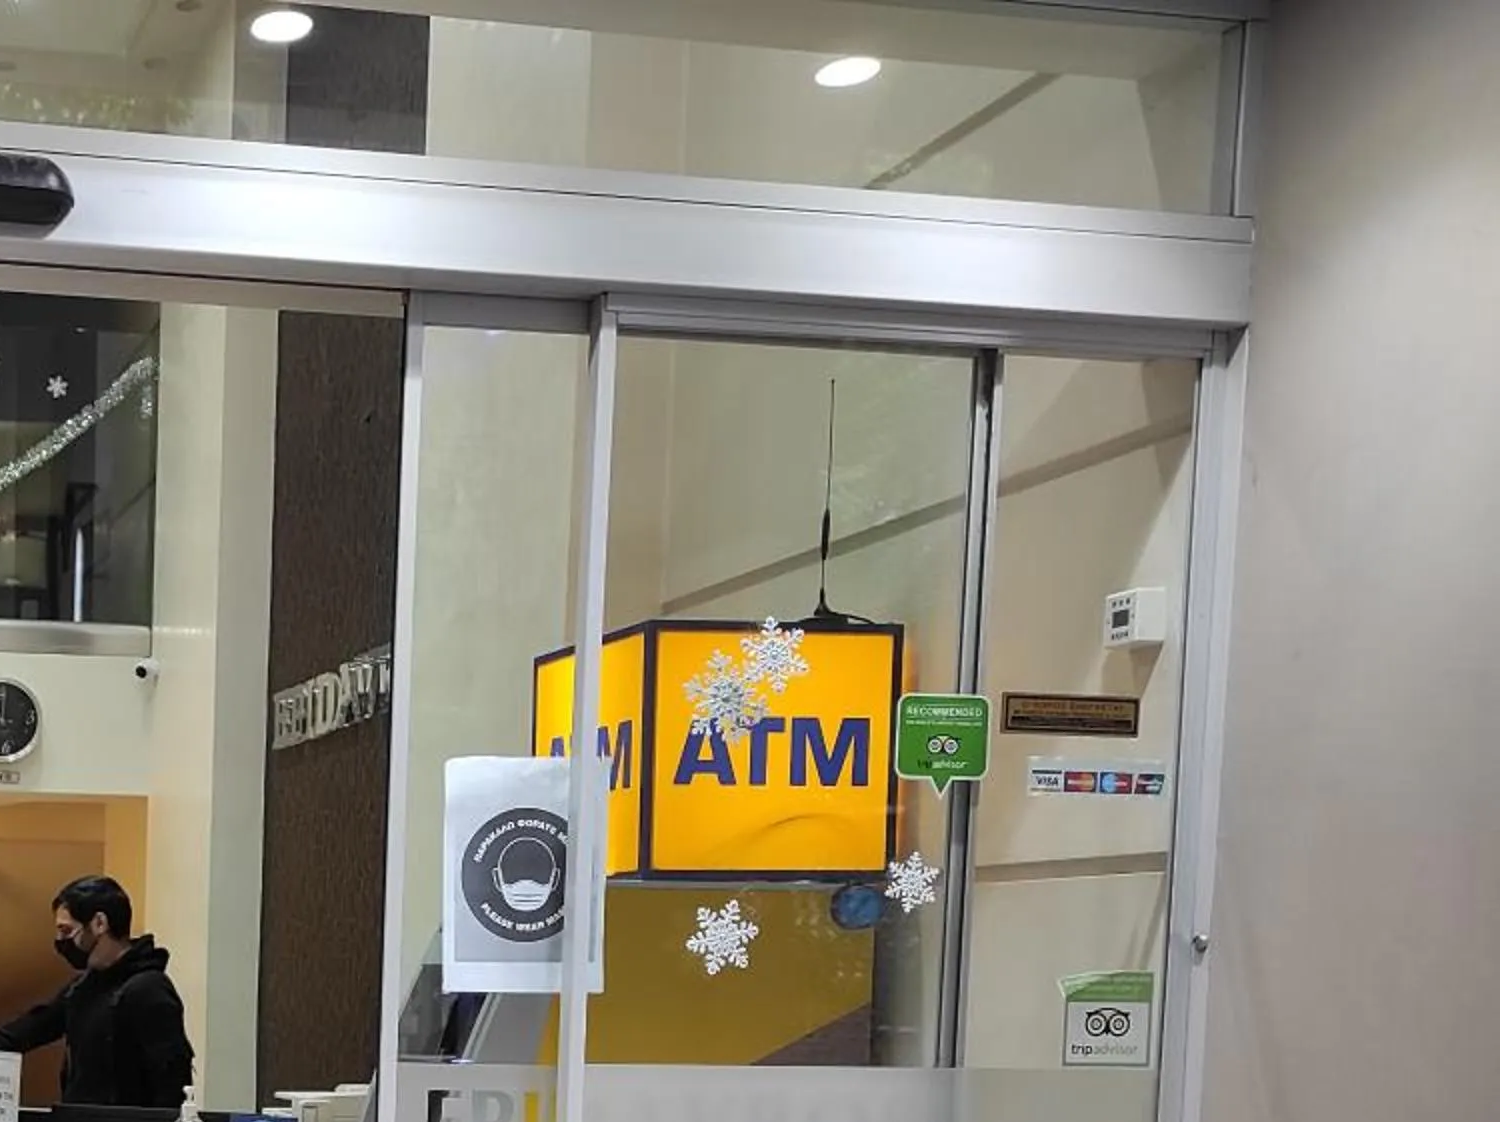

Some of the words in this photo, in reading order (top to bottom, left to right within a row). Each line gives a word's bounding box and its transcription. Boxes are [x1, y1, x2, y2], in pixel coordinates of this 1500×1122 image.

[673, 717, 870, 787] ATM
[1036, 775, 1059, 787] VISA
[545, 906, 565, 926] MAS
[1070, 1044, 1139, 1056] tripadvisor
